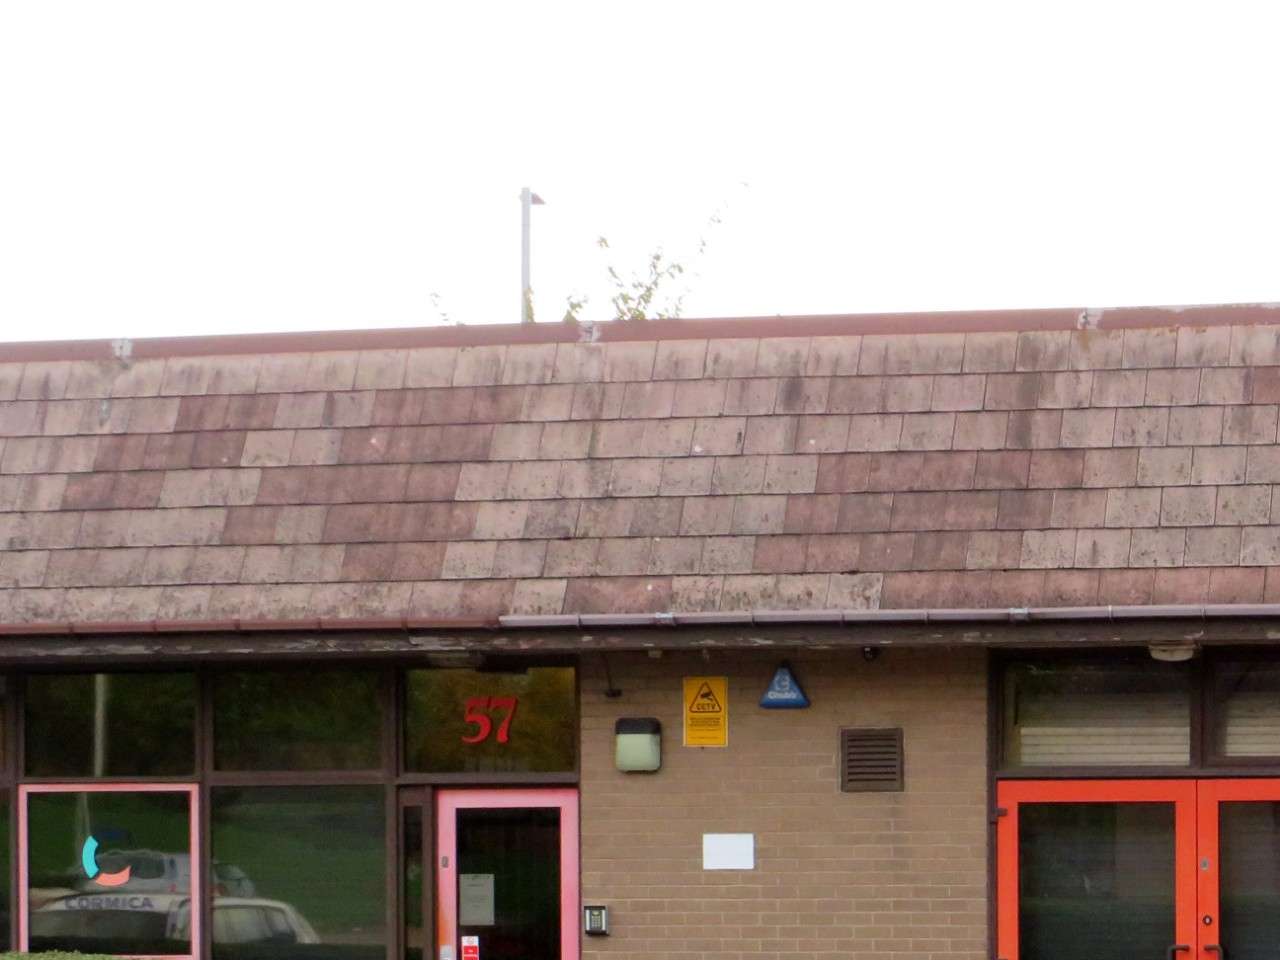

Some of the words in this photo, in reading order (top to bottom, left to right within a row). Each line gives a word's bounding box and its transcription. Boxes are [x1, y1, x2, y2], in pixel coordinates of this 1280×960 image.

[696, 702, 717, 710] CCTV
[461, 696, 518, 744] 57
[64, 896, 154, 909] CORMICA
